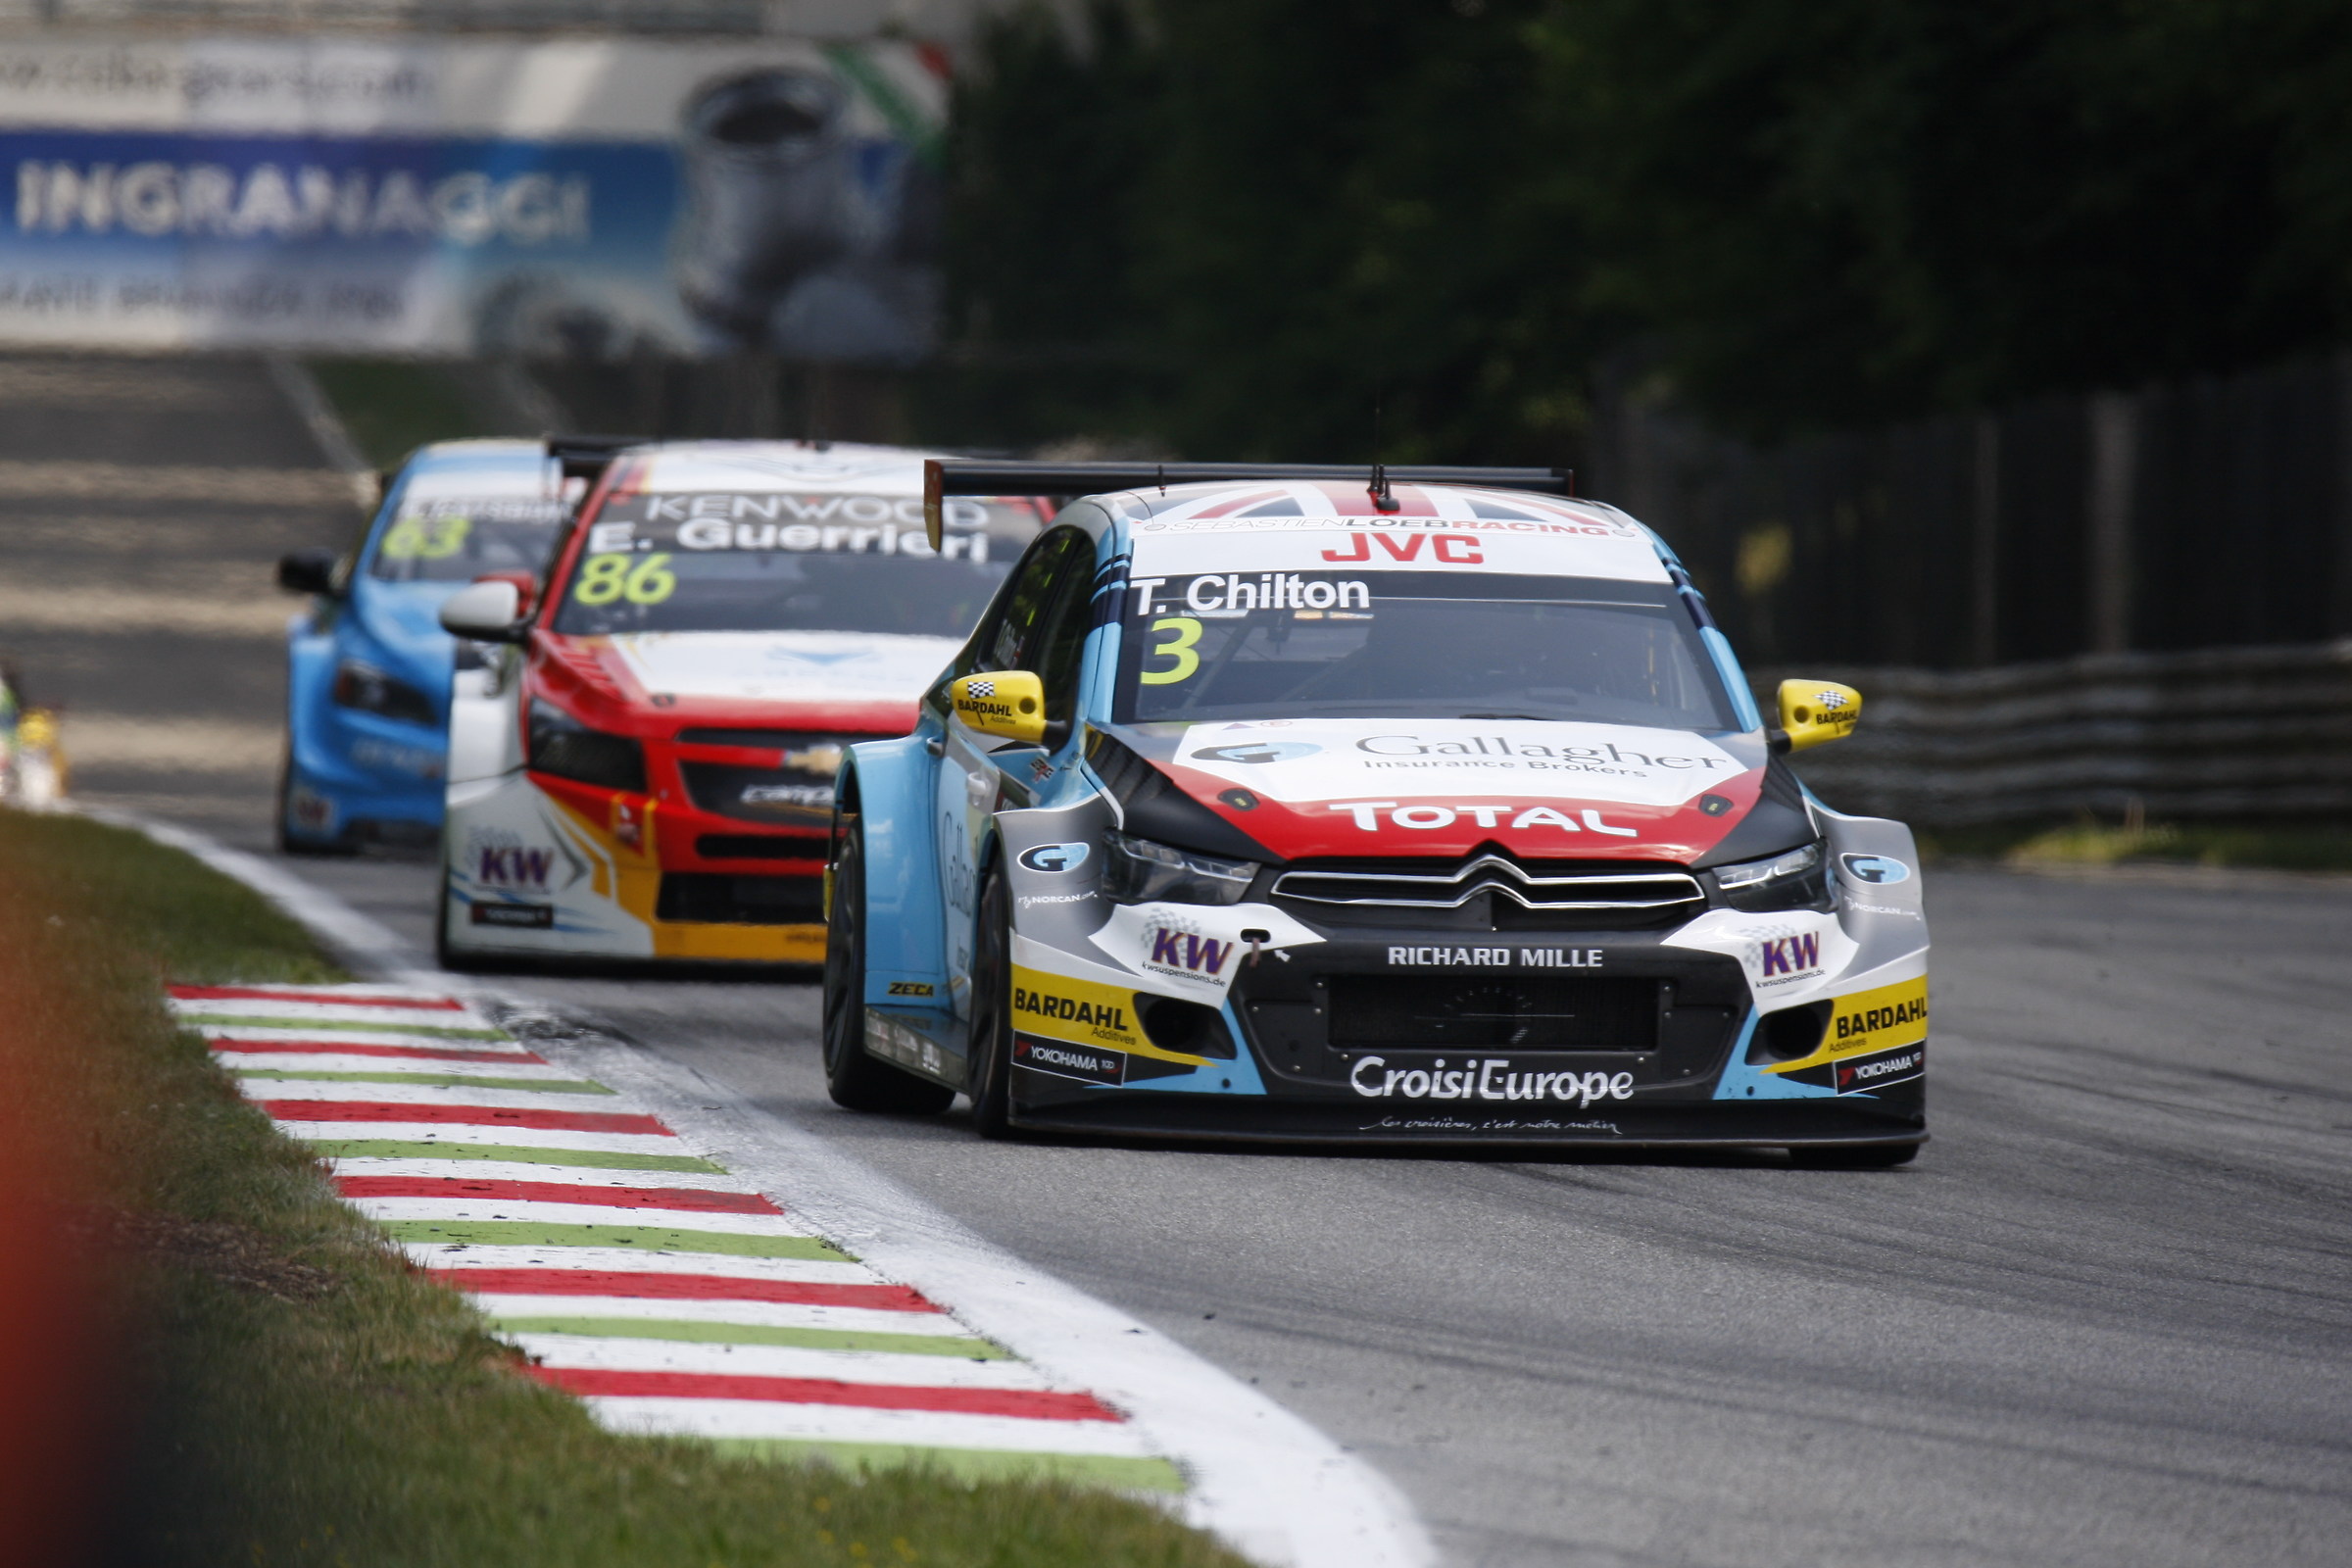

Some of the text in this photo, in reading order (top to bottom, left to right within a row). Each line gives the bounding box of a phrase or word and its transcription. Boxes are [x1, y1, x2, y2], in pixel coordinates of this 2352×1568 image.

[16, 159, 588, 245] INGRANAGGI
[644, 494, 990, 529] KENWOOD
[588, 516, 990, 563] E. Guerrieri
[1320, 531, 1485, 565] JVC
[572, 552, 677, 607] 86
[1131, 572, 1371, 616] T. Chilton
[1140, 617, 1204, 686] 3
[957, 699, 1012, 716] BARDAHL
[1355, 734, 1728, 770] Gallagher
[1364, 760, 1647, 778] Insurance Brokers
[480, 845, 555, 889] KW
[1151, 927, 1234, 976] KW
[1388, 947, 1604, 968] RICHARD MILLE
[1762, 931, 1820, 978] KW
[1141, 960, 1226, 988] kwsuspensions.de
[1014, 987, 1129, 1033] BARDAHL
[1836, 996, 1928, 1040] BARDAHL
[1091, 1027, 1137, 1047] Additives
[1829, 1037, 1867, 1054] Additives
[1031, 1045, 1099, 1071] YOKOHAMA
[1855, 1055, 1913, 1080] YOKOHAMA
[1350, 1055, 1635, 1109] CroisiEurope
